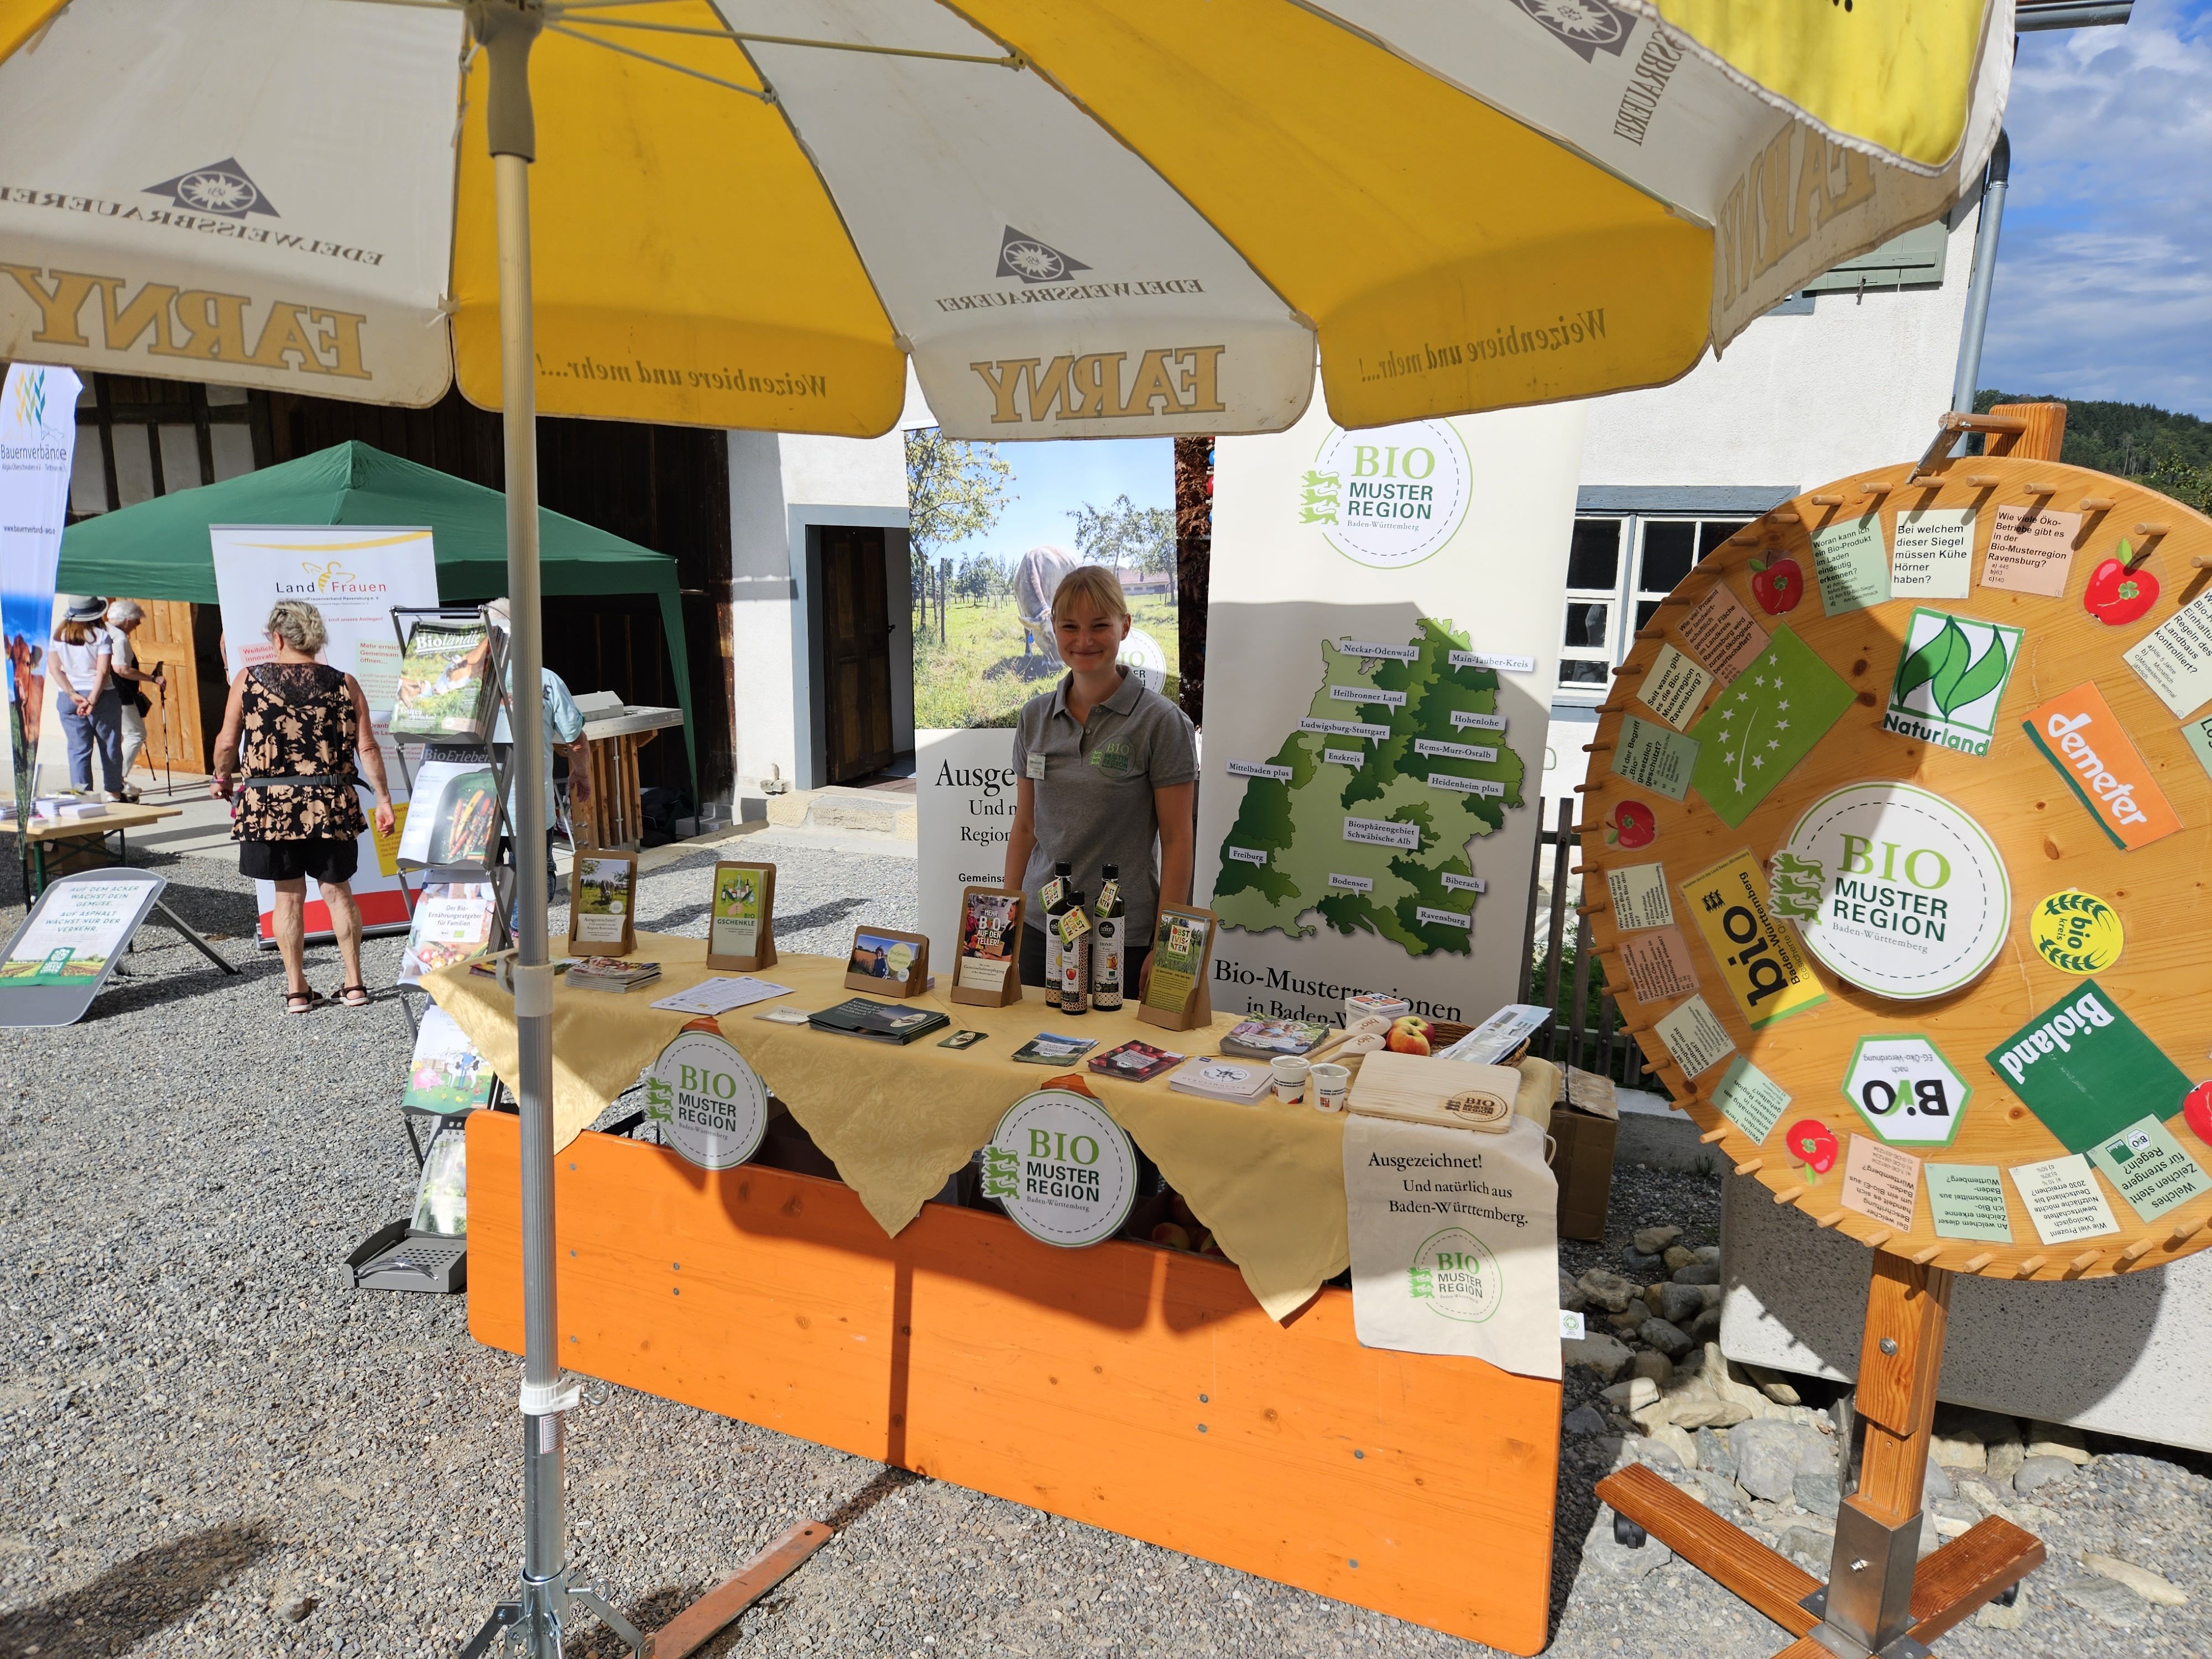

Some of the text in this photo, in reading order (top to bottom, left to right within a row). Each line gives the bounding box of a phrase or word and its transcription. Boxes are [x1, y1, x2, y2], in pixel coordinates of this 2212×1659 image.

[1351, 445, 1436, 480] BIO
[1349, 482, 1433, 501] MUSTER
[1348, 500, 1432, 520] REGION
[1999, 512, 2014, 520] Wie
[2040, 515, 2061, 526] Öko-
[1347, 520, 1420, 531] Baden-Württemberg
[1898, 525, 1963, 534] Bei welchem
[1996, 523, 2032, 533] Betriebe
[1813, 526, 1870, 548] Woran kann ich
[1828, 535, 1871, 554] Bio-Produkt
[1897, 537, 1963, 547] dieser Siegel
[1827, 552, 1849, 563] Laden
[1895, 550, 1936, 559] müssen
[1991, 542, 2067, 559] Bio-Musterregion
[1818, 561, 1851, 575] eindeutig
[1988, 553, 2046, 568] Ravensburg?
[1820, 568, 1857, 584] erkennen?
[1894, 575, 1931, 583] haben?
[276, 582, 387, 593] Land Frauen
[2164, 623, 2199, 659] Landbaus
[2173, 615, 2212, 656] Regeln des
[1344, 644, 1415, 658] Neckar-Odenwald
[2154, 630, 2198, 674] kontrolliert?
[1452, 654, 1529, 669] Main-Tauber-Kreis
[1647, 653, 1681, 706] Seit wann gibt
[1333, 689, 1402, 702] Heilbronner Land
[1656, 672, 1681, 712] es die Bio-
[1662, 668, 1694, 718] Musterregion
[1669, 673, 1702, 724] Ravensburg?
[1301, 721, 1386, 738] Ludwigsburg-Stuttgart
[1455, 715, 1499, 727] Hohenlohe
[1628, 721, 1640, 748] Begriff
[1883, 713, 1990, 757] Naturland
[1107, 743, 1130, 755] BIO
[1328, 752, 1360, 763] Enzkreis
[1418, 743, 1491, 759] Rems-Murr-Ostalb
[1229, 762, 1289, 779] Mittelbaden plus
[1637, 742, 1652, 783] gesetzlich
[1646, 742, 1662, 787] geschützt?
[2047, 712, 2147, 826] demeter
[935, 759, 1018, 797] Ausge
[1432, 777, 1499, 794] Heidenheim plus
[969, 799, 1004, 816] Und
[1347, 829, 1411, 846] Schwäbische Alb
[1348, 820, 1415, 836] Biosphärengebiet
[1233, 850, 1264, 862] Freiburg
[1837, 833, 1952, 890] BIO
[1332, 877, 1368, 888] Bodensee
[1445, 877, 1480, 889] Biberach
[1835, 877, 1948, 919] MUSTER
[1420, 911, 1466, 926] Ravensburg
[1833, 899, 1946, 942] REGION
[977, 929, 1001, 939] AUF DEN
[1739, 872, 1800, 985] Baden-Württemberg
[1833, 922, 1928, 954] Baden-Württemberg
[2057, 918, 2068, 940] kreis
[2067, 916, 2092, 949] bio
[977, 937, 1000, 947] TELLER!
[1723, 906, 1788, 1007] bio
[1785, 935, 1809, 980] Gesicherte
[1246, 997, 1264, 1014] in
[1999, 992, 2115, 1085] Bioland
[1864, 1053, 1933, 1062] EG-Öko-Verordnung
[679, 1064, 737, 1099] BIO
[679, 1093, 736, 1117] MUSTER
[1465, 1097, 1495, 1107] BIO
[679, 1107, 735, 1132] REGION
[679, 1123, 728, 1140] Baden-Württemberg
[1027, 1129, 1099, 1165] BIO
[1368, 1151, 1483, 1172] Ausgezeichnet!
[2123, 1147, 2164, 1175] Regeln?
[1027, 1161, 1099, 1185] MUSTER
[2121, 1152, 2185, 1190] für strengere
[1027, 1178, 1099, 1202] REGION
[1403, 1180, 1512, 1198] Und natürlich aus
[2130, 1163, 2198, 1204] Zeichen steht
[1027, 1196, 1089, 1212] Baden-Württemberg
[2151, 1182, 2197, 1208] Welches
[1389, 1200, 1528, 1227] Baden-Württemberg.
[1436, 1252, 1480, 1274] BIO
[1438, 1272, 1482, 1288] MUSTER
[1439, 1283, 1483, 1298] REGION
